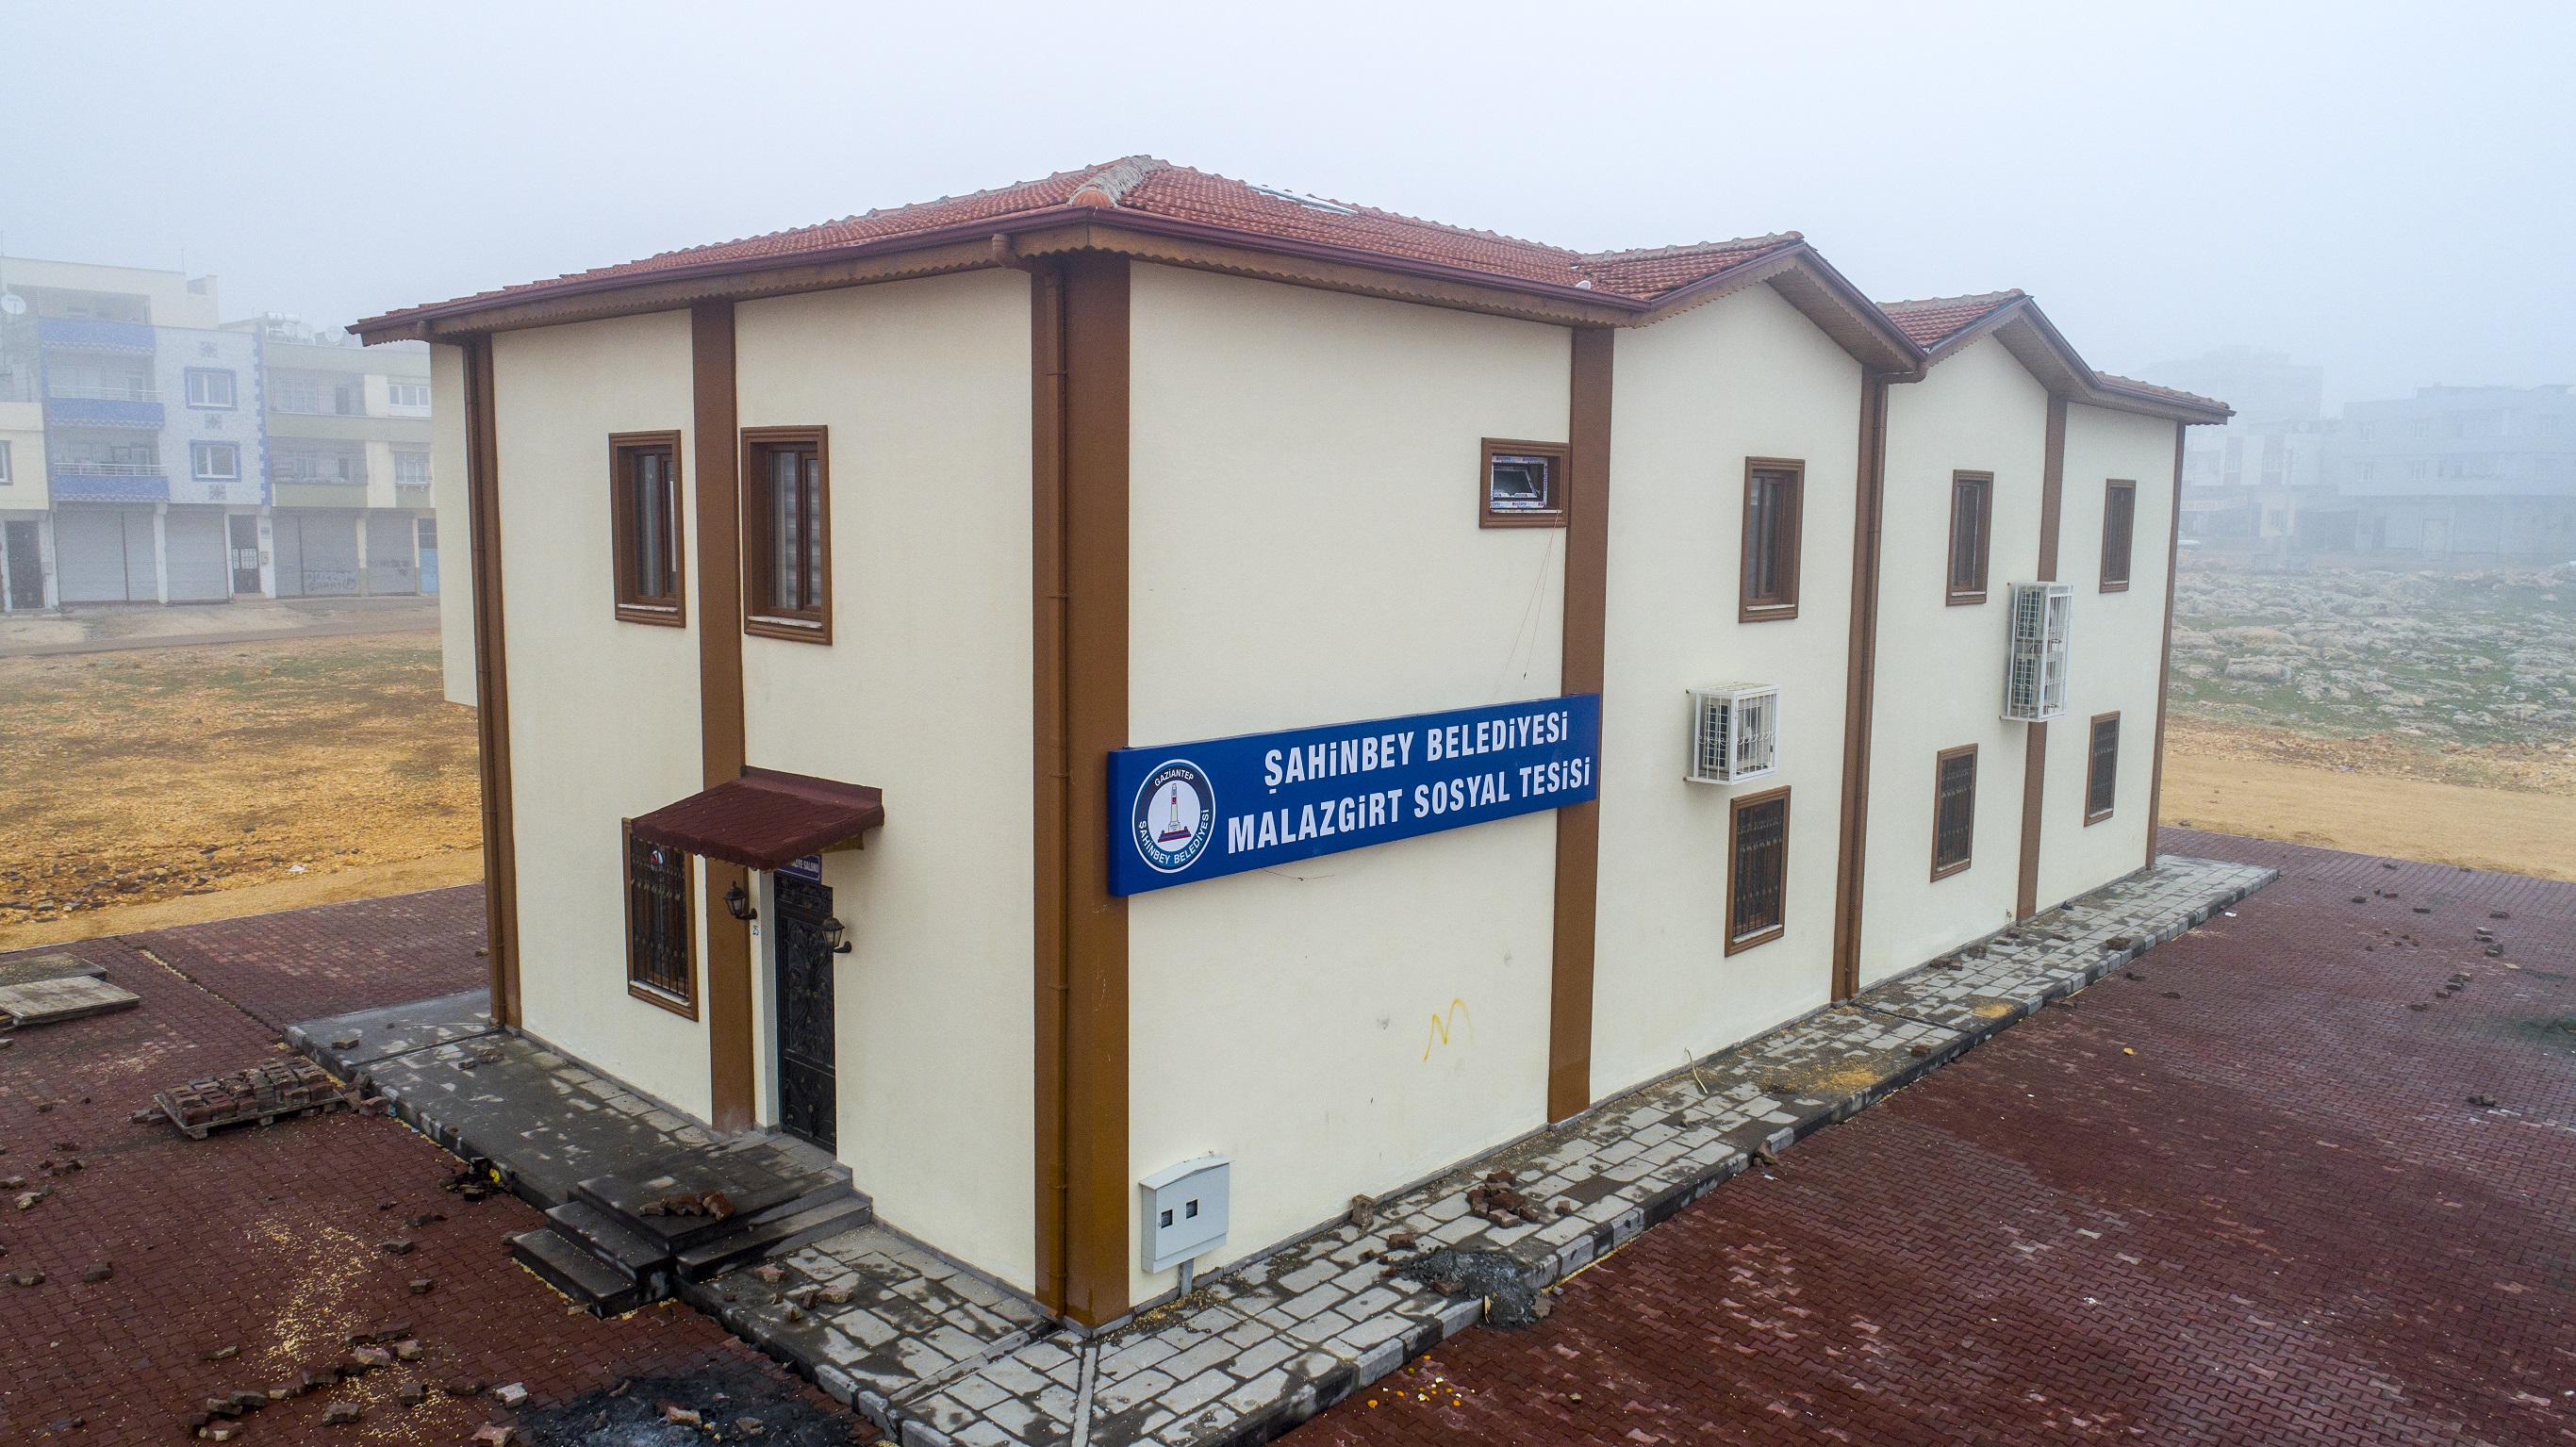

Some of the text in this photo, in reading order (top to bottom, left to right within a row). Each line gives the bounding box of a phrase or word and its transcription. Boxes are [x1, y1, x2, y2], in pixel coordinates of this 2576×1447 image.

[1154, 768, 1194, 786] GAZİANTEP
[1414, 771, 1510, 818] SOSYAL
[1138, 809, 1210, 864] ŞAHİNBEY BELEDİYESİ
